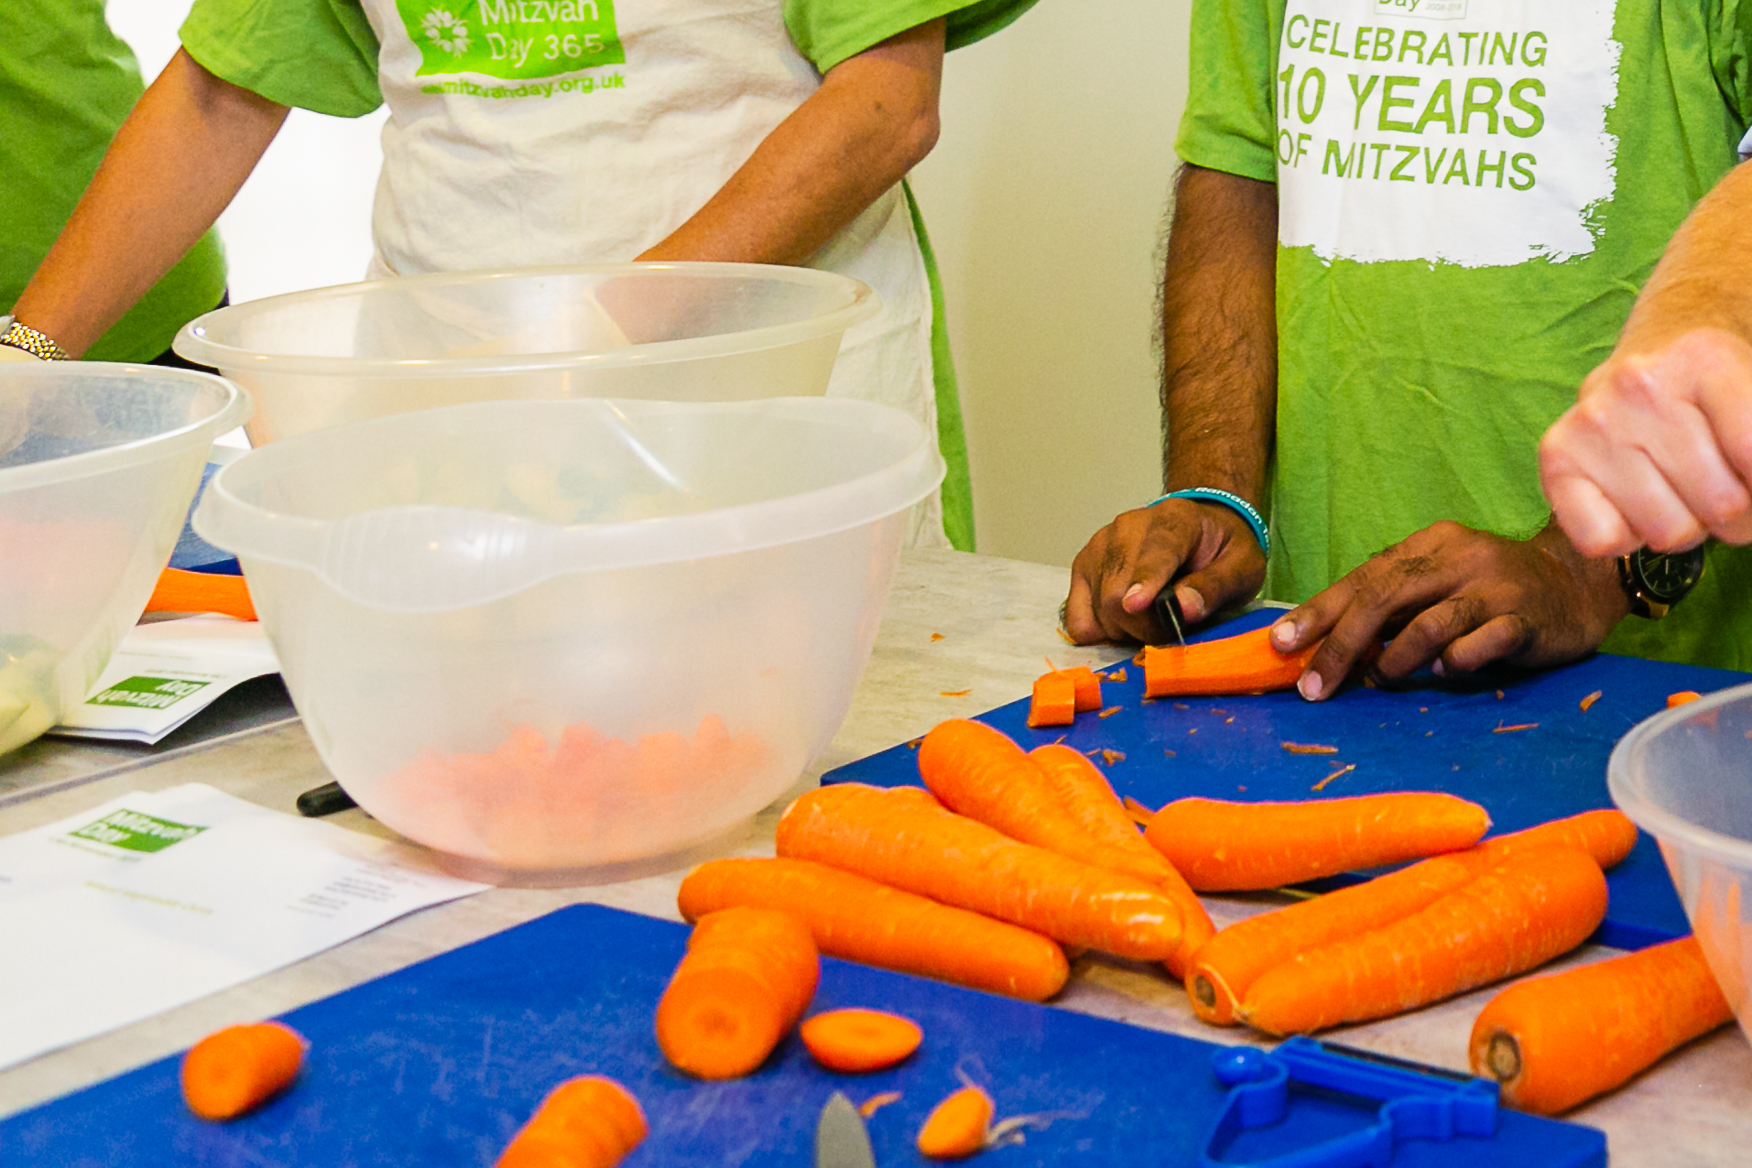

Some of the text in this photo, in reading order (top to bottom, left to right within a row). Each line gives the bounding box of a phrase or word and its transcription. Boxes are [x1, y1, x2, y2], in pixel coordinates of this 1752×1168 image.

[485, 32, 604, 69] Day 365
[1286, 14, 1548, 67] CELEBRATING
[1279, 63, 1546, 139] 10 YEARS
[1279, 128, 1537, 192] OF MITZVAHS
